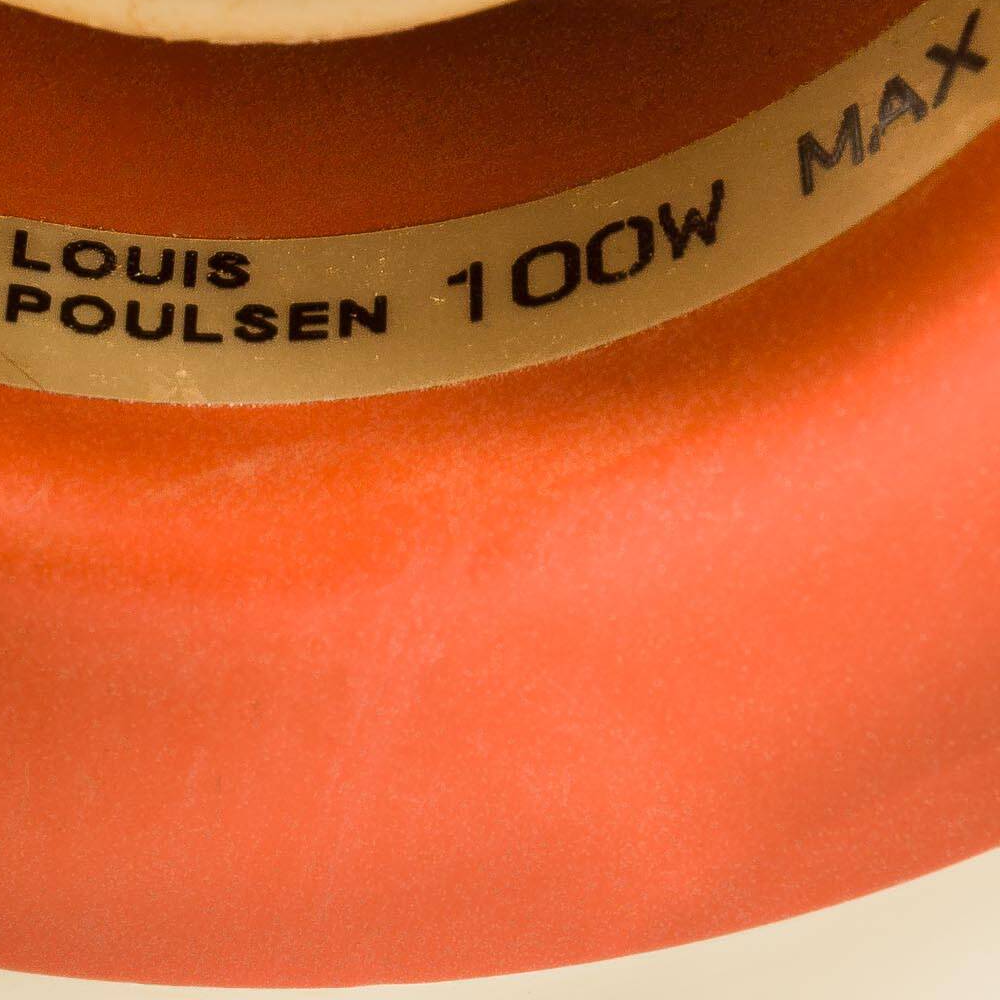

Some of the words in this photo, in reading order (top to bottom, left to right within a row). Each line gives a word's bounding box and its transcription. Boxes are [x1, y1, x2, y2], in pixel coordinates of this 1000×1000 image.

[447, 178, 725, 322] 100W
[797, 7, 989, 196] MAX
[12, 228, 252, 289] LOUIS
[5, 283, 388, 342] POULSEN
